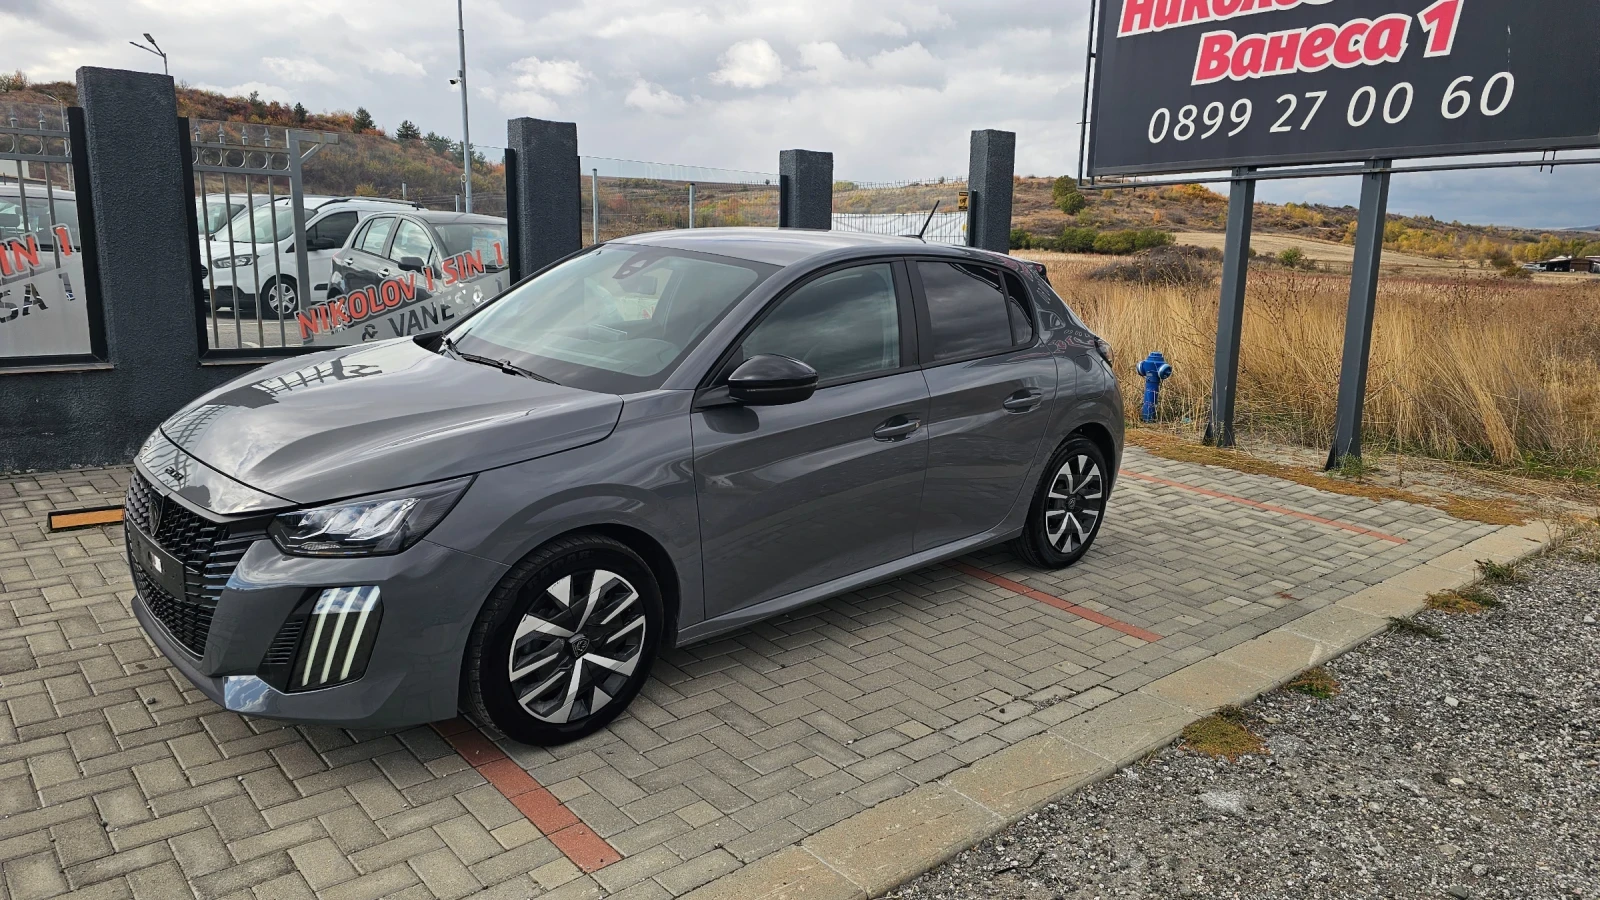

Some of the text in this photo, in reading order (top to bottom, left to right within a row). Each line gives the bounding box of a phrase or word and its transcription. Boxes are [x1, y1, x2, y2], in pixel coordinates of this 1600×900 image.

[1191, 0, 1464, 86] Ванеса 1
[1148, 71, 1515, 143] 0899 27 00 60
[295, 272, 416, 342] NIKOLOV
[441, 249, 485, 286] SIN
